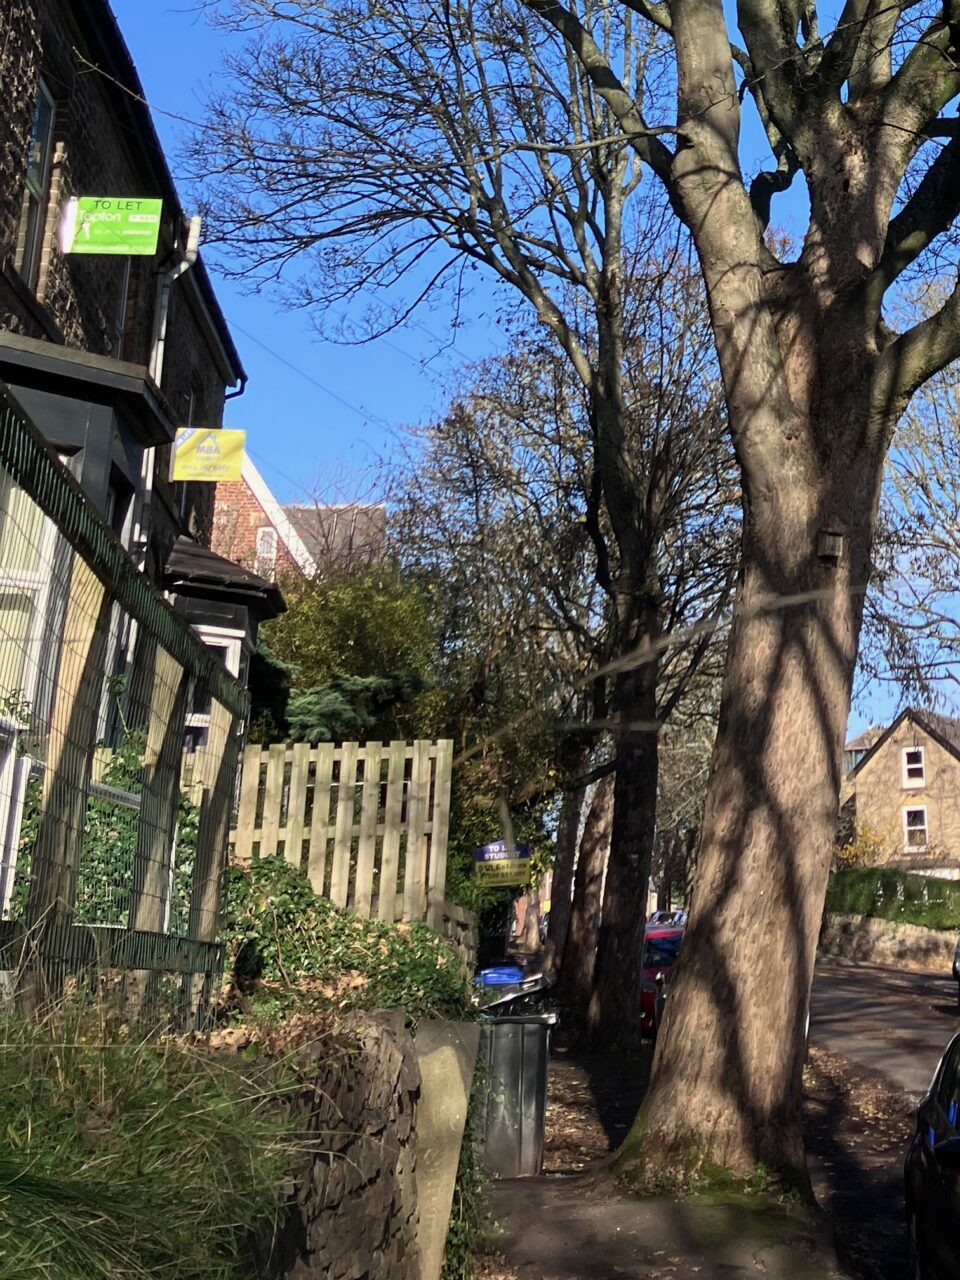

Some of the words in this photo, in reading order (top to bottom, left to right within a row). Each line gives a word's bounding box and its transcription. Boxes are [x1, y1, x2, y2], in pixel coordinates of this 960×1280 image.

[93, 200, 112, 210] TO
[117, 201, 144, 211] LET
[196, 446, 220, 454] MBA
[484, 851, 521, 860] STUDT
